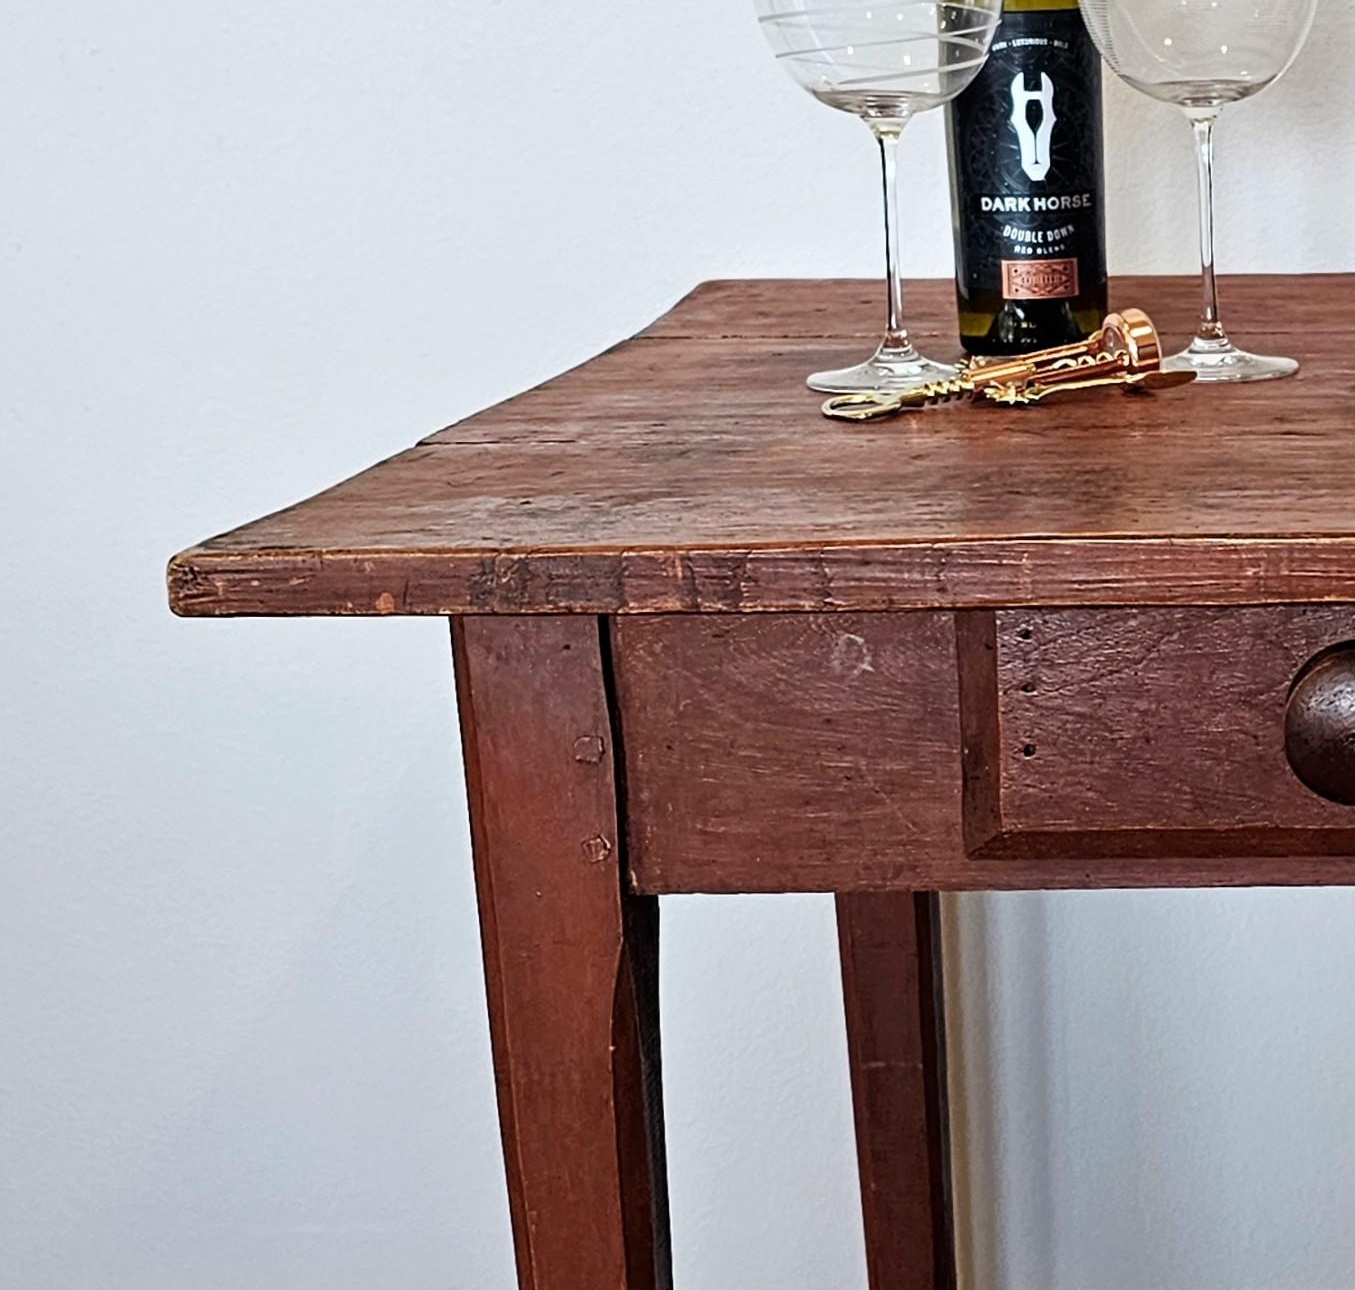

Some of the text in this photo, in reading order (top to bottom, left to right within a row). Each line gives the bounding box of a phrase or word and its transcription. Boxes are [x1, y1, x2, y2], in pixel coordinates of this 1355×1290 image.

[981, 194, 1092, 212] DARK HORSE
[1003, 224, 1075, 243] DOUBLE DOWN
